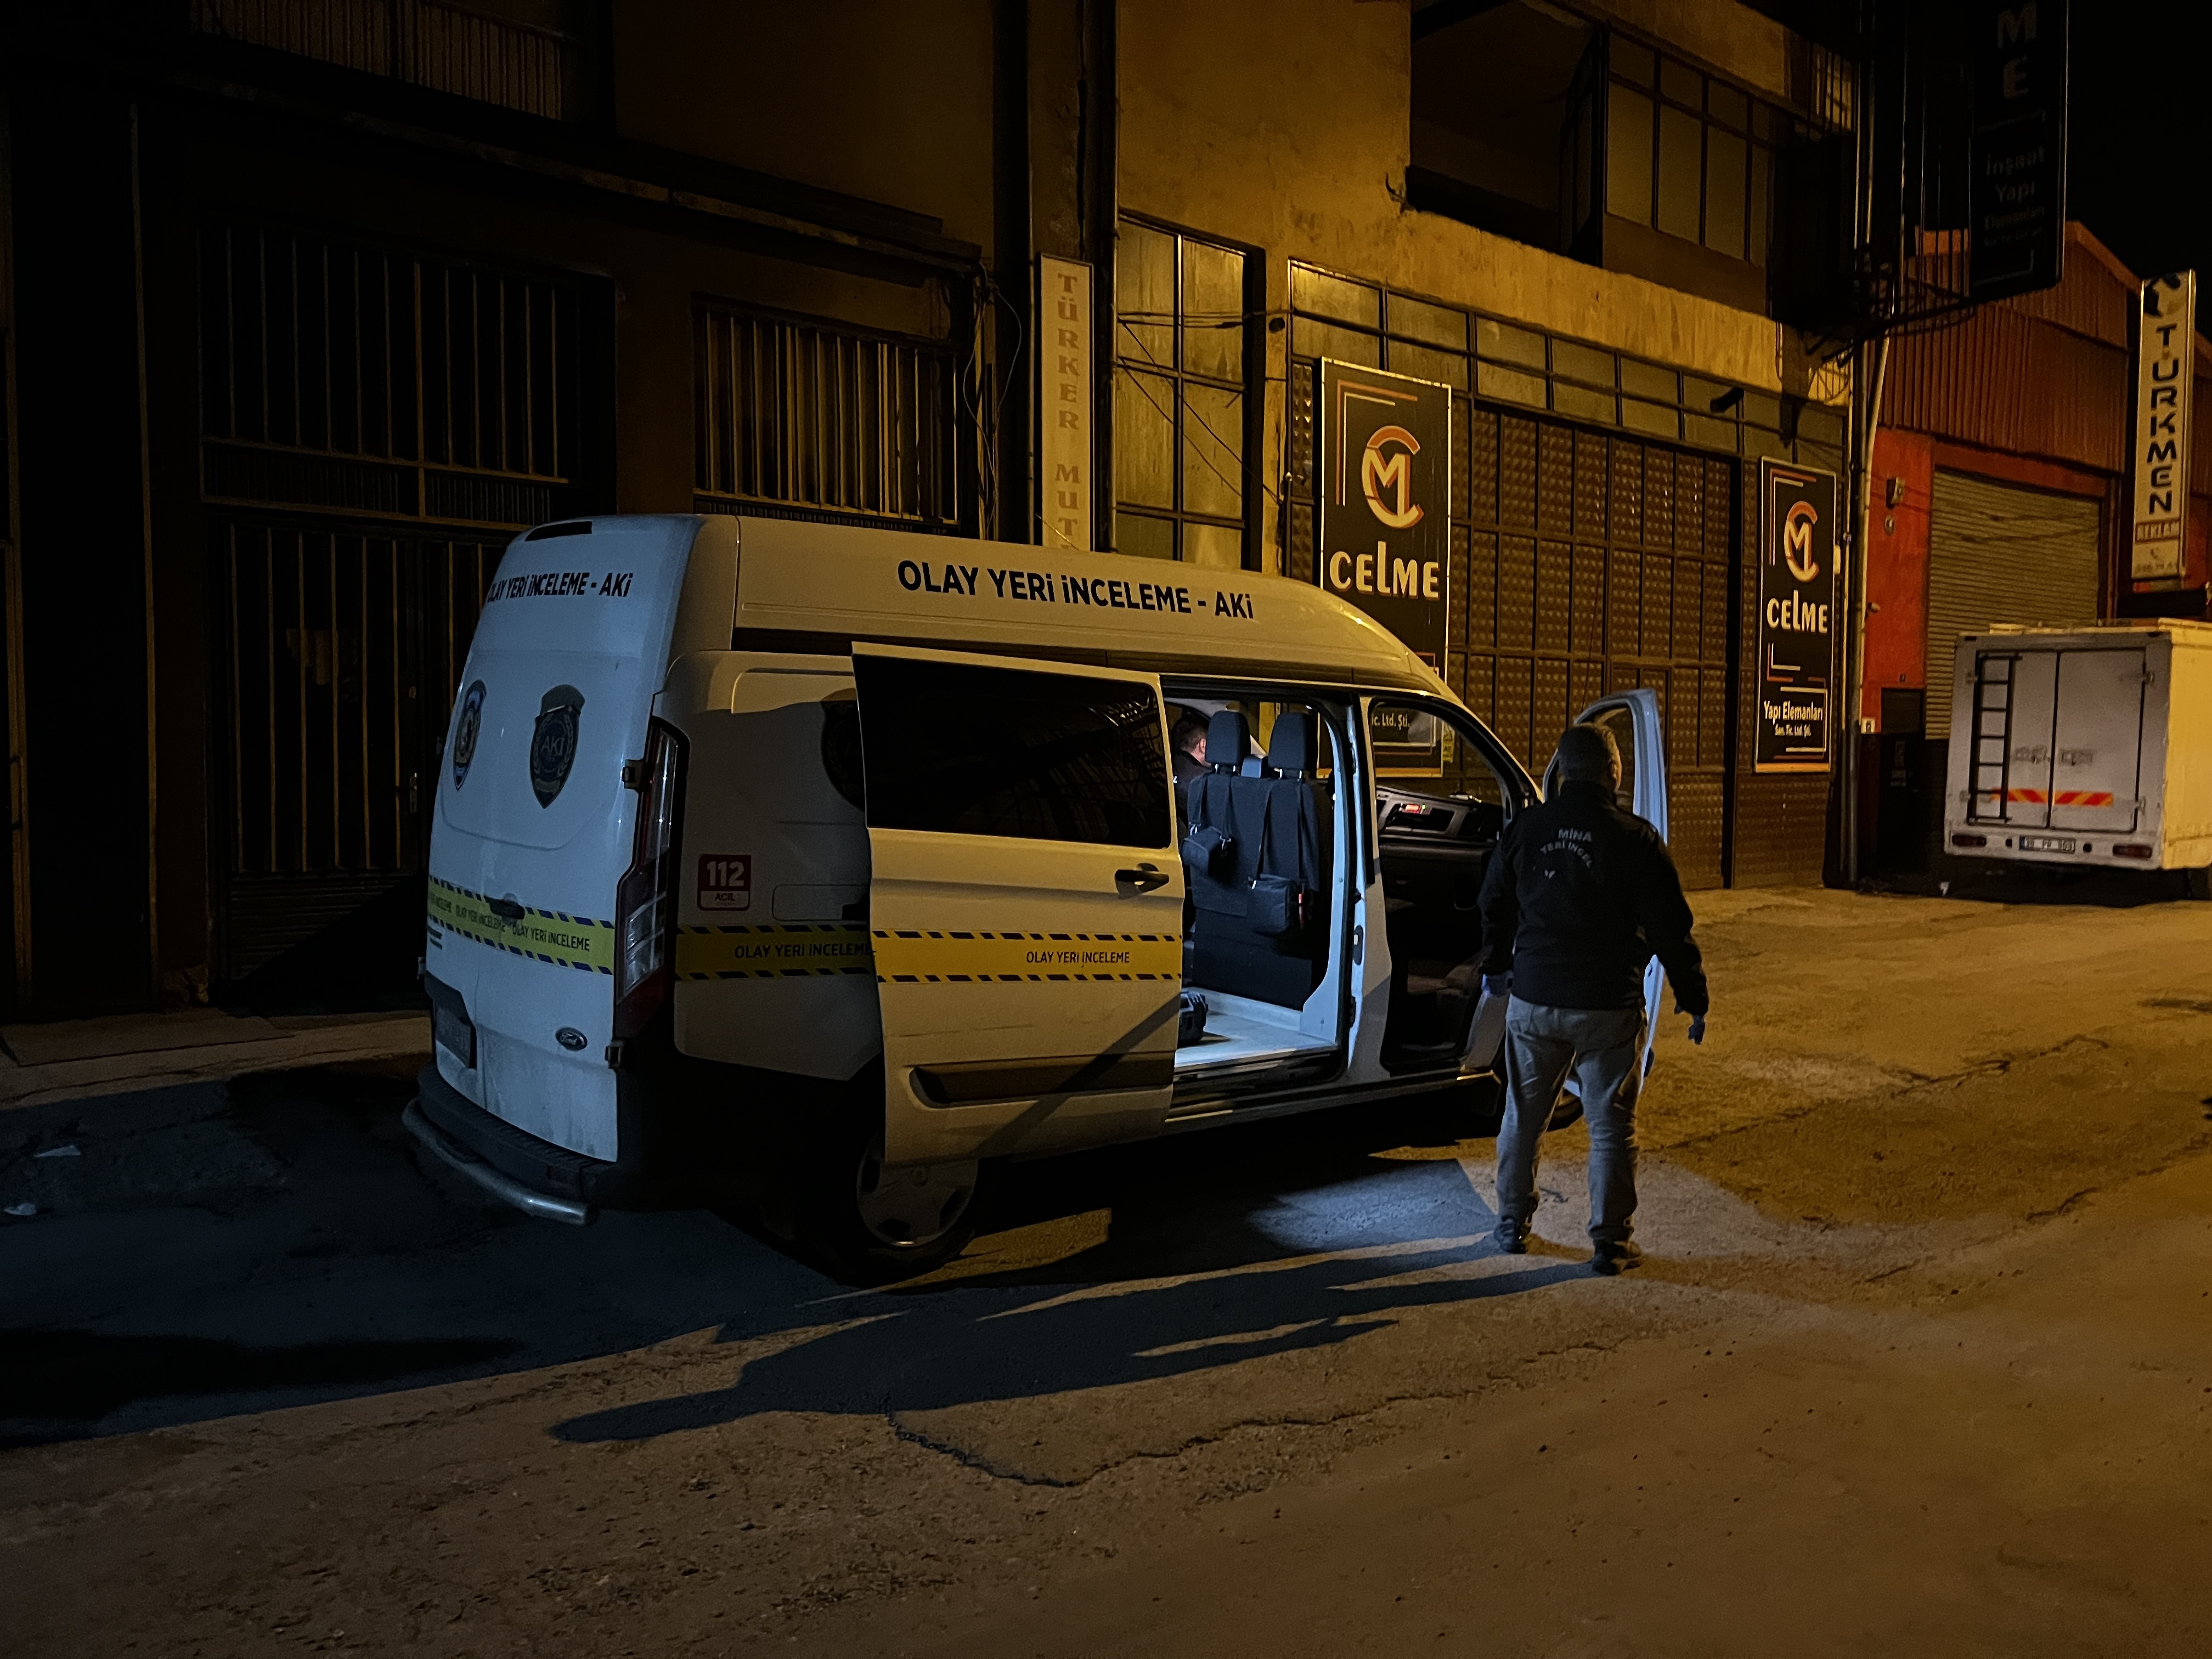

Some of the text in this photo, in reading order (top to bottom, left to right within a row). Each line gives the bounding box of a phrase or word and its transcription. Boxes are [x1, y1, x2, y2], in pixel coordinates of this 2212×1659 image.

[1056, 273, 1080, 549] TÜRKER MUT
[898, 560, 979, 596] OLAY
[1329, 540, 1440, 599] CELME
[1767, 589, 1829, 633] CELME
[1382, 713, 1397, 727] Ltd.
[1764, 699, 1823, 725] Yapı Elemanları
[706, 861, 745, 887] 112
[512, 924, 529, 938] OLAY
[735, 945, 771, 958] OLAY
[1026, 951, 1054, 963] OLAY
